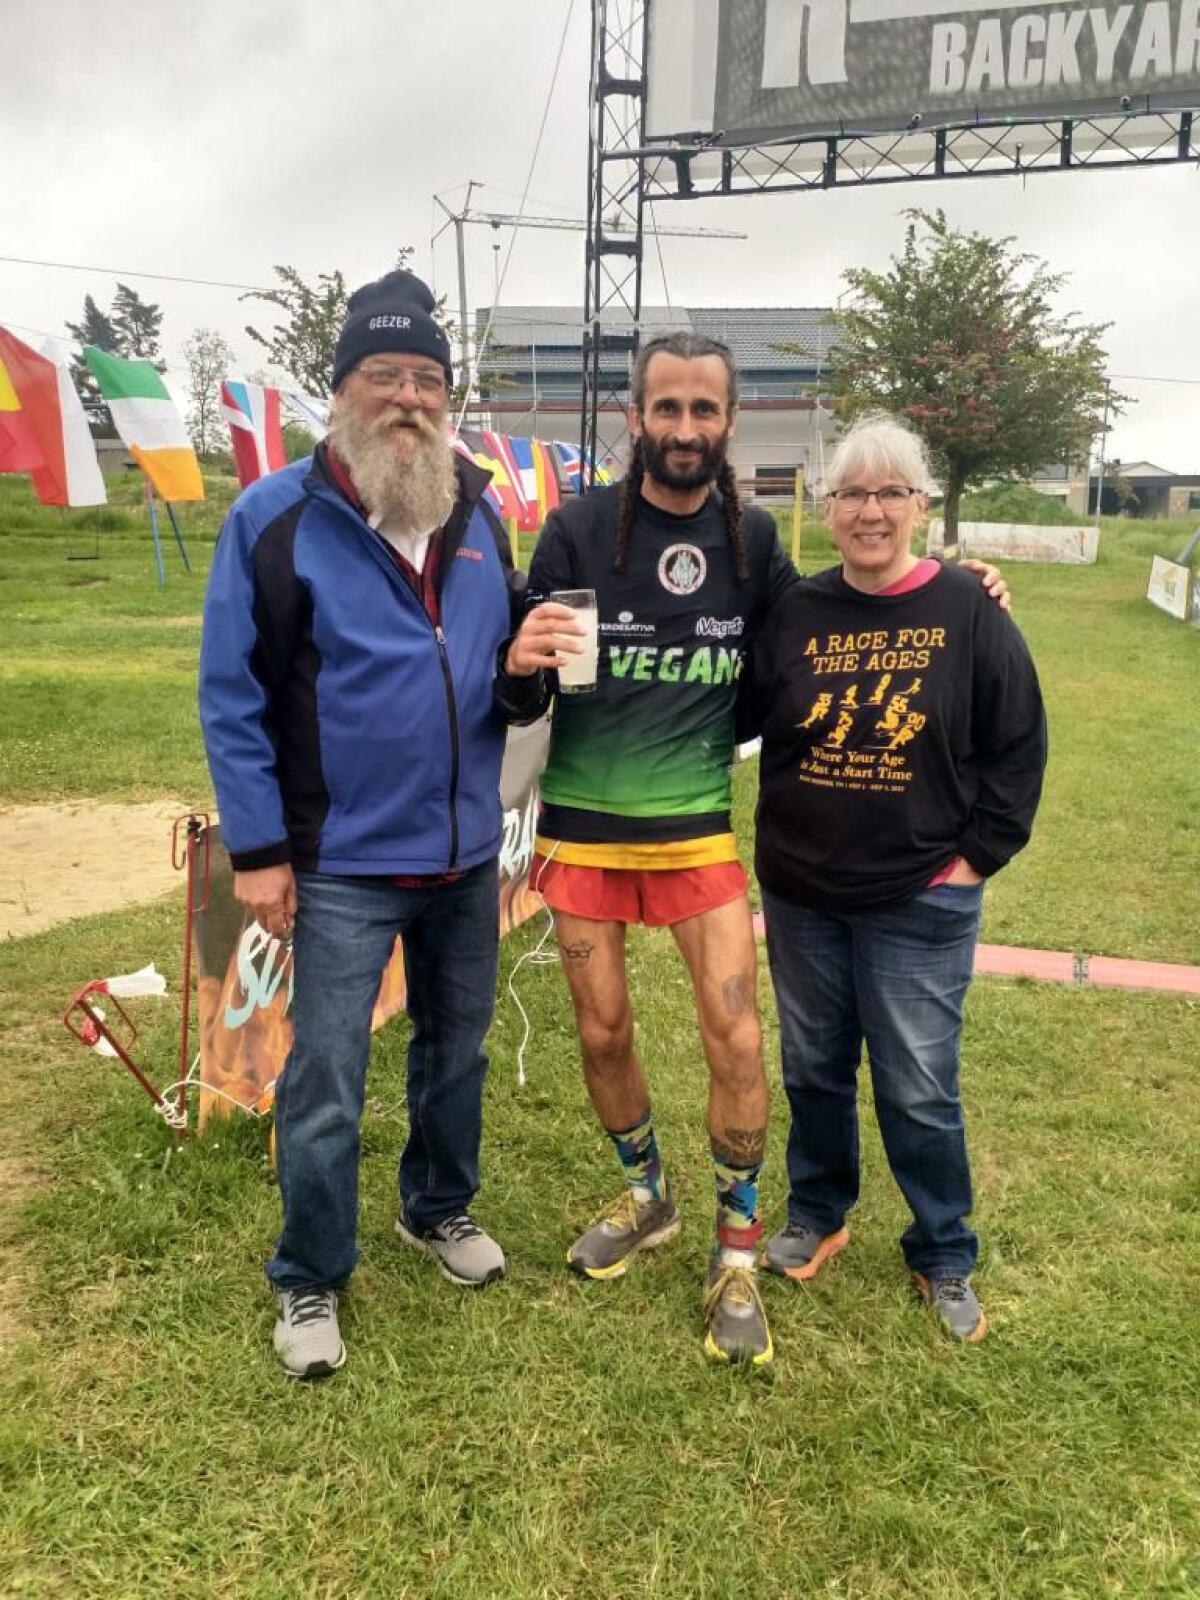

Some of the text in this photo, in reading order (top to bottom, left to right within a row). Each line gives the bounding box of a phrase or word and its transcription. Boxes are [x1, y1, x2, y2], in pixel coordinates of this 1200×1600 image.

[369, 315, 412, 331] GEEZER
[803, 627, 946, 656] A RACE FOR
[609, 645, 738, 685] VEGAN
[813, 649, 931, 675] THE AGES
[811, 746, 906, 768] Where Your Age
[842, 765, 873, 778] Start
[878, 766, 913, 781] Time
